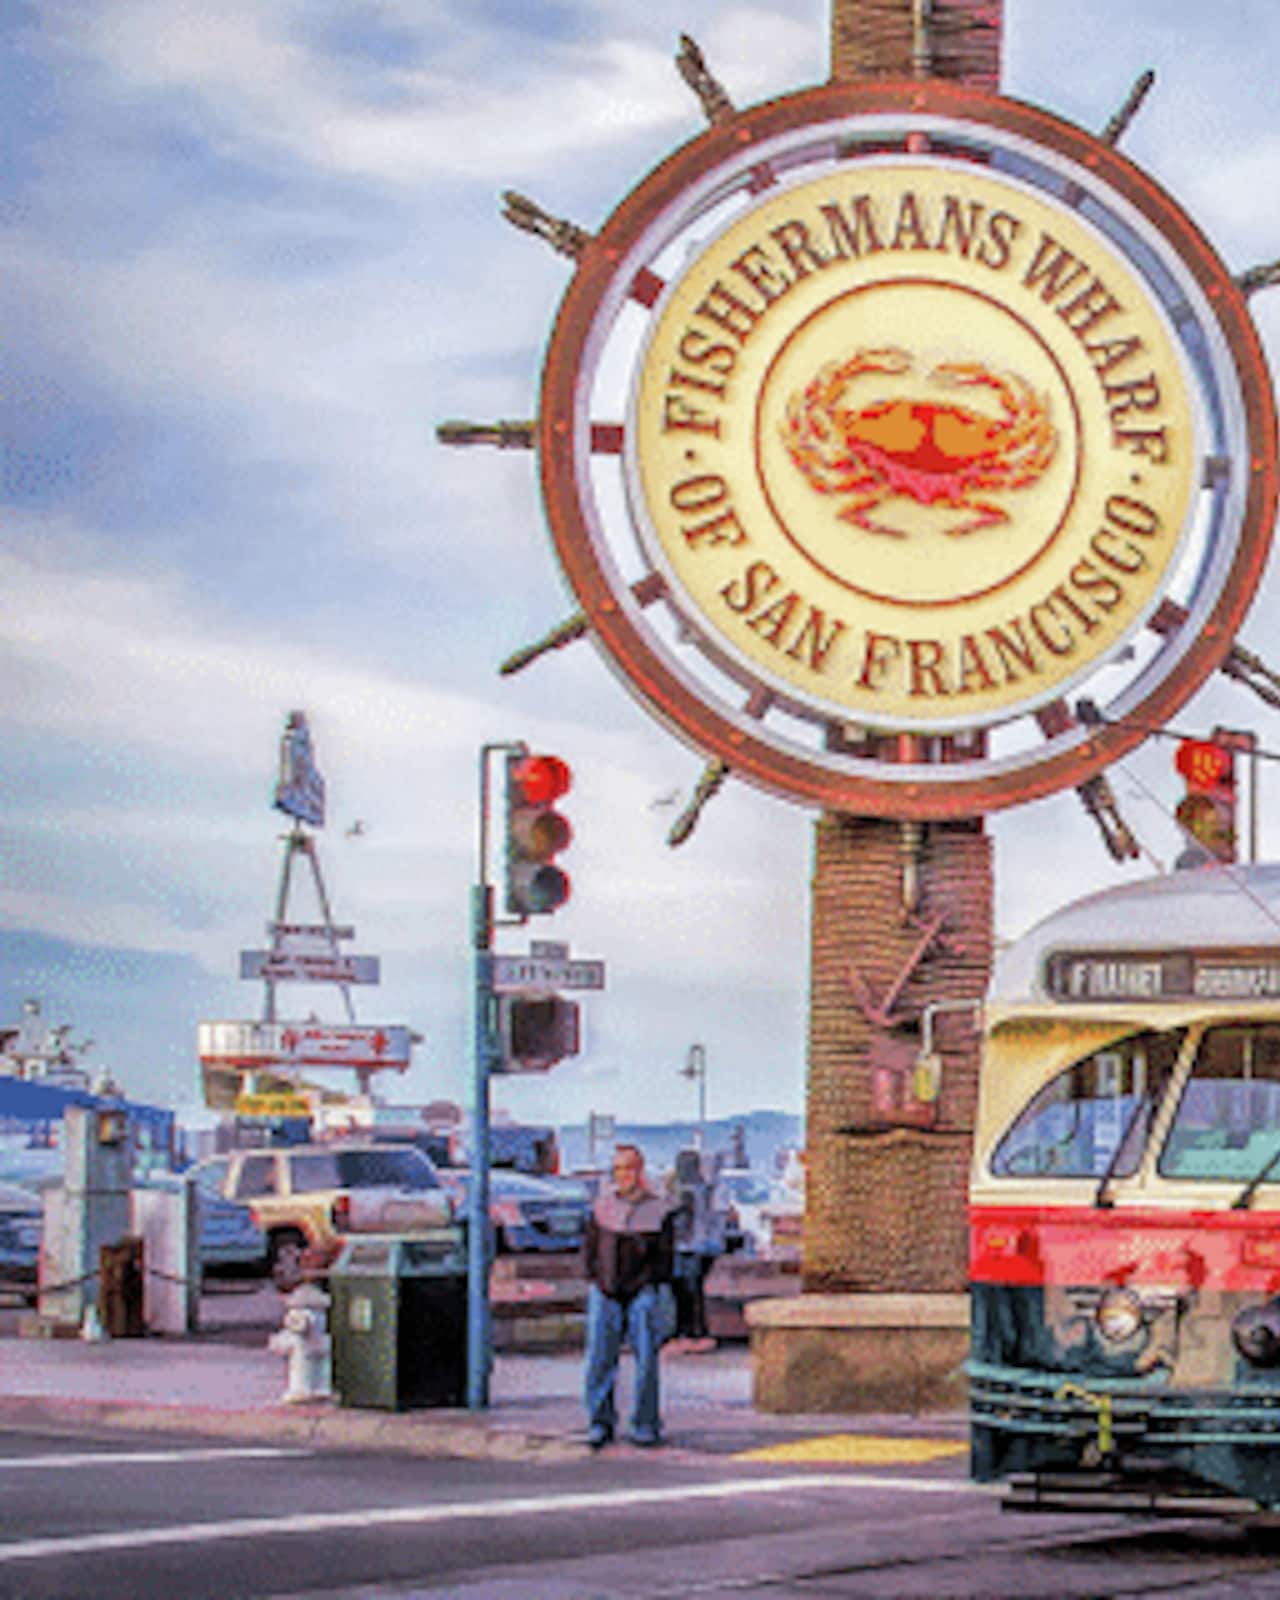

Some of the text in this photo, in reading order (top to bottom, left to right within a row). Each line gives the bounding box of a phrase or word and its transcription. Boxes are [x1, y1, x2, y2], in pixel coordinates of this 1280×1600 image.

[663, 191, 1170, 465] FISHERMANS WHARF
[668, 473, 1160, 696] OF SAN FRANCISCO
